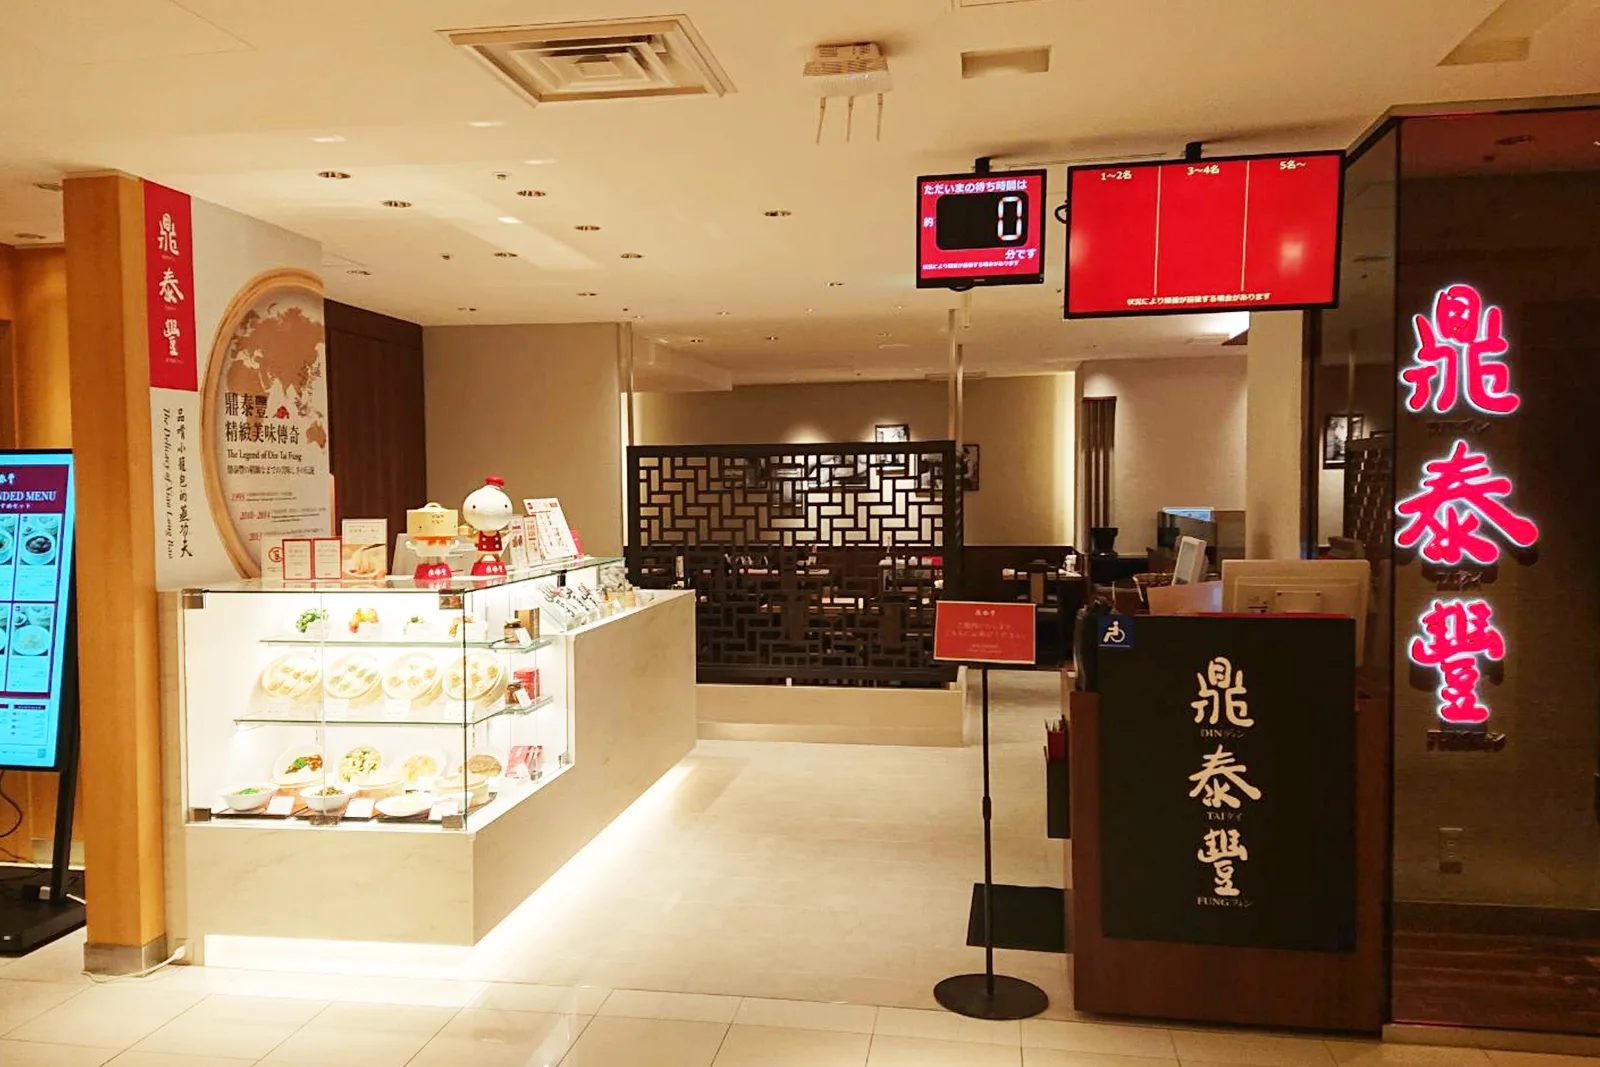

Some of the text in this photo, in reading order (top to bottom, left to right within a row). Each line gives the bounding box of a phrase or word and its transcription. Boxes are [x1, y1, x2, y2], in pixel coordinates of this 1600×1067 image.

[924, 179, 1027, 195] ただいまの待ち時間は
[923, 217, 934, 228] 約
[998, 196, 1022, 241] 0
[1005, 248, 1037, 260] 分です
[225, 392, 268, 419] 鼎泰豐
[225, 420, 300, 445] 精緻美味傳奇
[227, 449, 237, 459] The
[239, 449, 260, 461] Legend
[261, 450, 268, 459] of
[25, 491, 56, 502] MENU
[1200, 728, 1222, 737] DIN
[1206, 811, 1225, 821] TAI
[1197, 896, 1229, 907] FUNG
